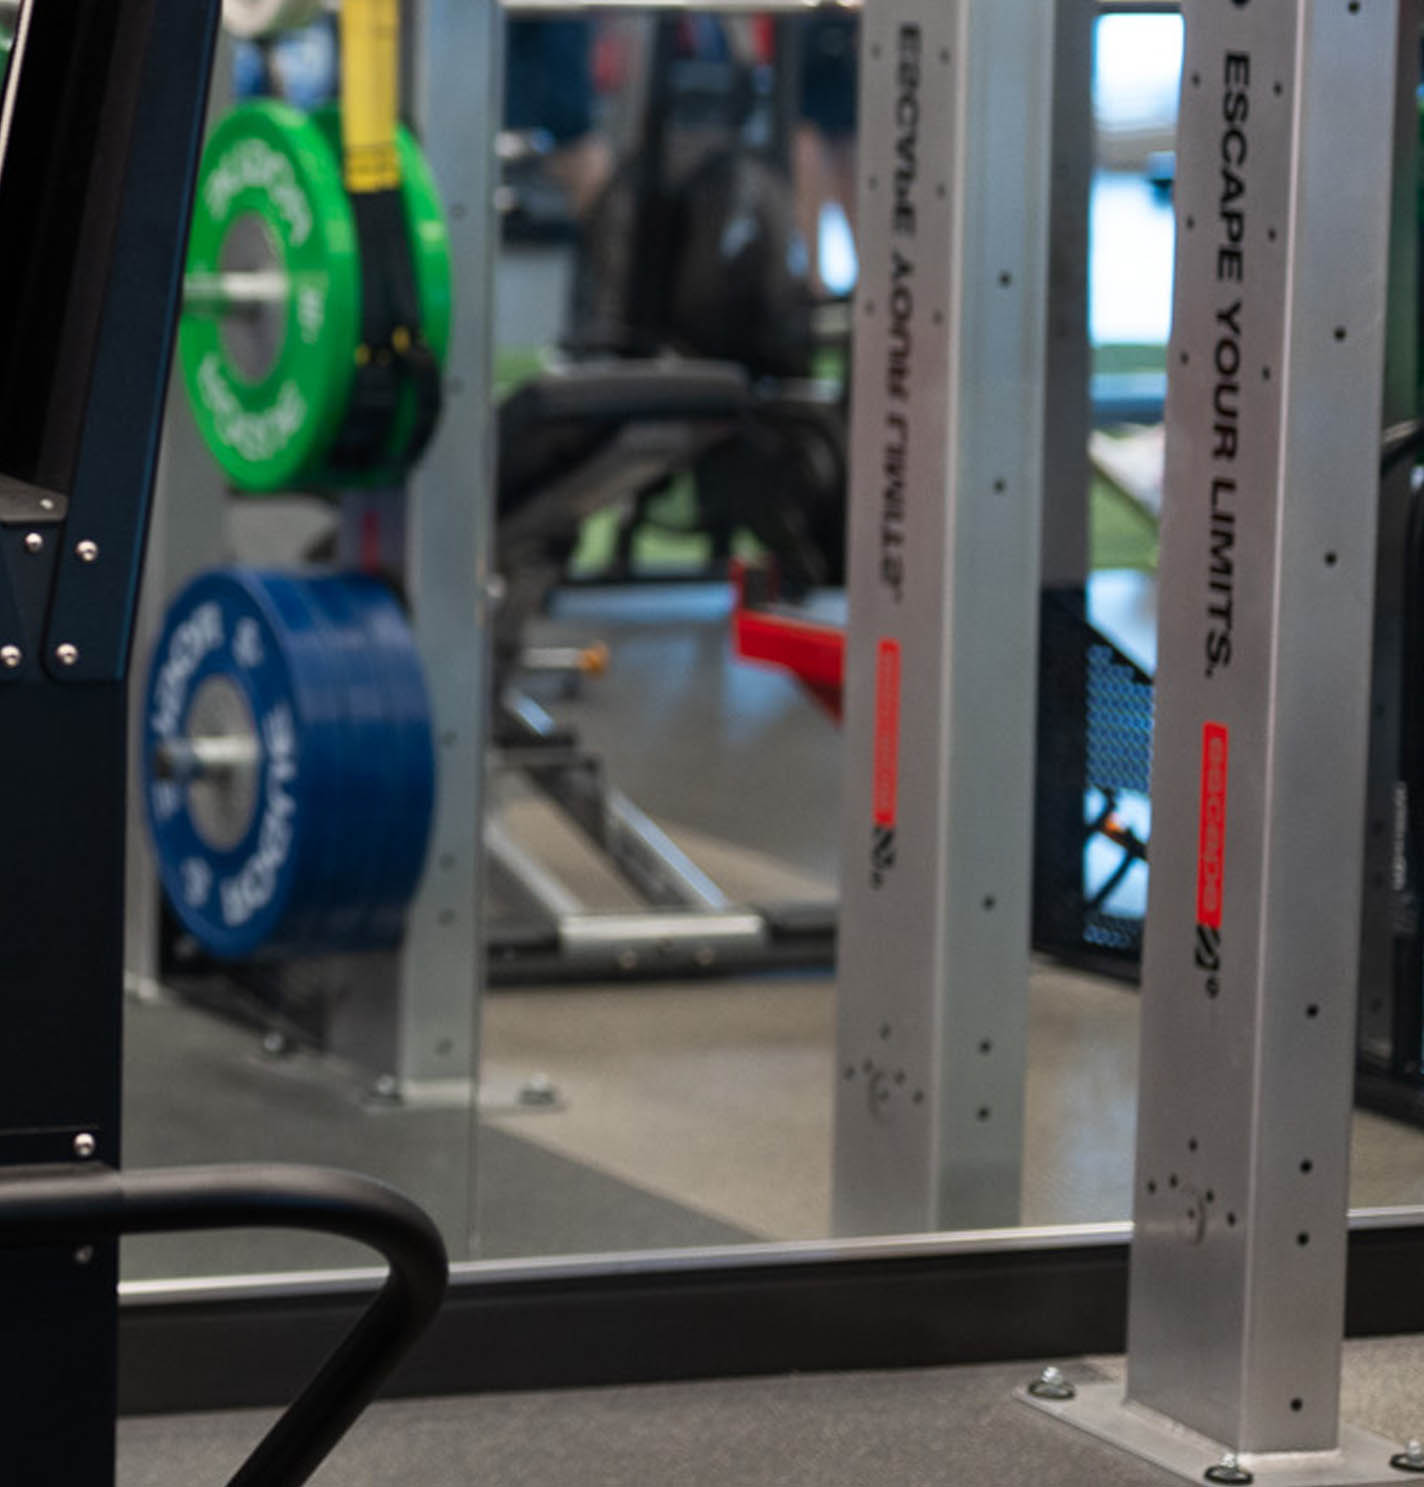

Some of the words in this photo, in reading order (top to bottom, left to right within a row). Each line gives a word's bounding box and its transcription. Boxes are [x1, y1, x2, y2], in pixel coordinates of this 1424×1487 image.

[1217, 52, 1250, 282] ESCAPE
[1210, 299, 1242, 463] YOUR
[1205, 476, 1237, 679] LIMITS.
